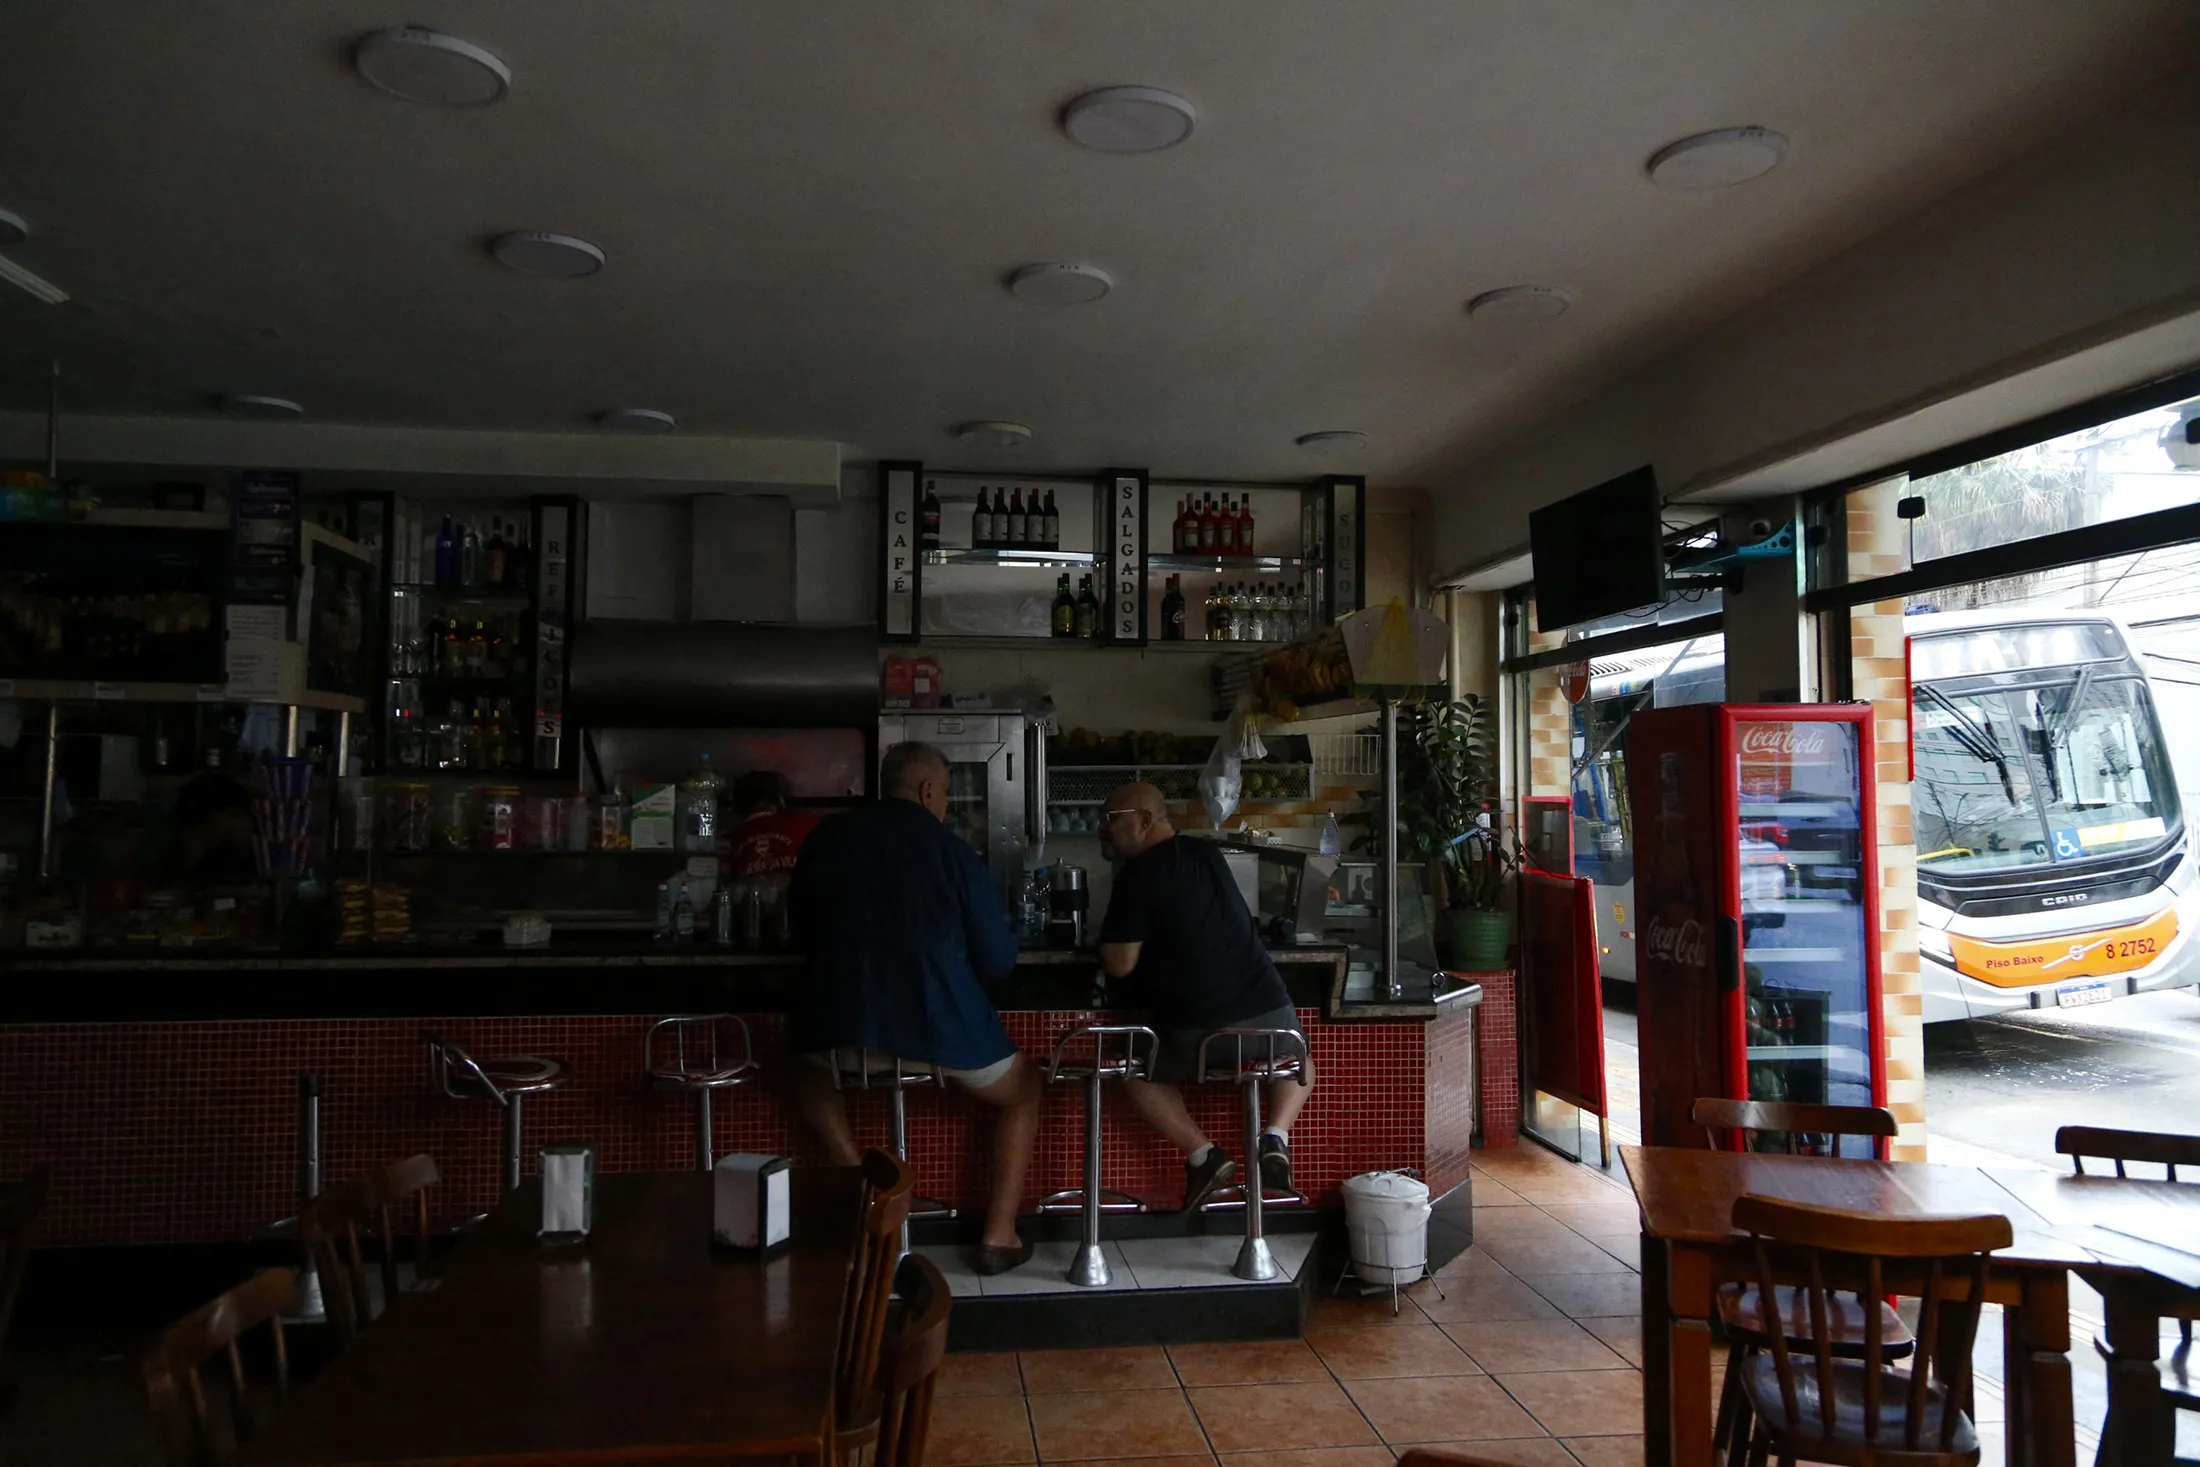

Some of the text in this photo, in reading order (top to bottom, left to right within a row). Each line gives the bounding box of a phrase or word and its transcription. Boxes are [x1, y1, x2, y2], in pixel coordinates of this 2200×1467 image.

[894, 510, 907, 593] CAFÉ
[1120, 486, 1134, 633] SALGADOS
[1986, 955, 2044, 968] Piso Baixo
[2105, 938, 2156, 959] 8 2752
